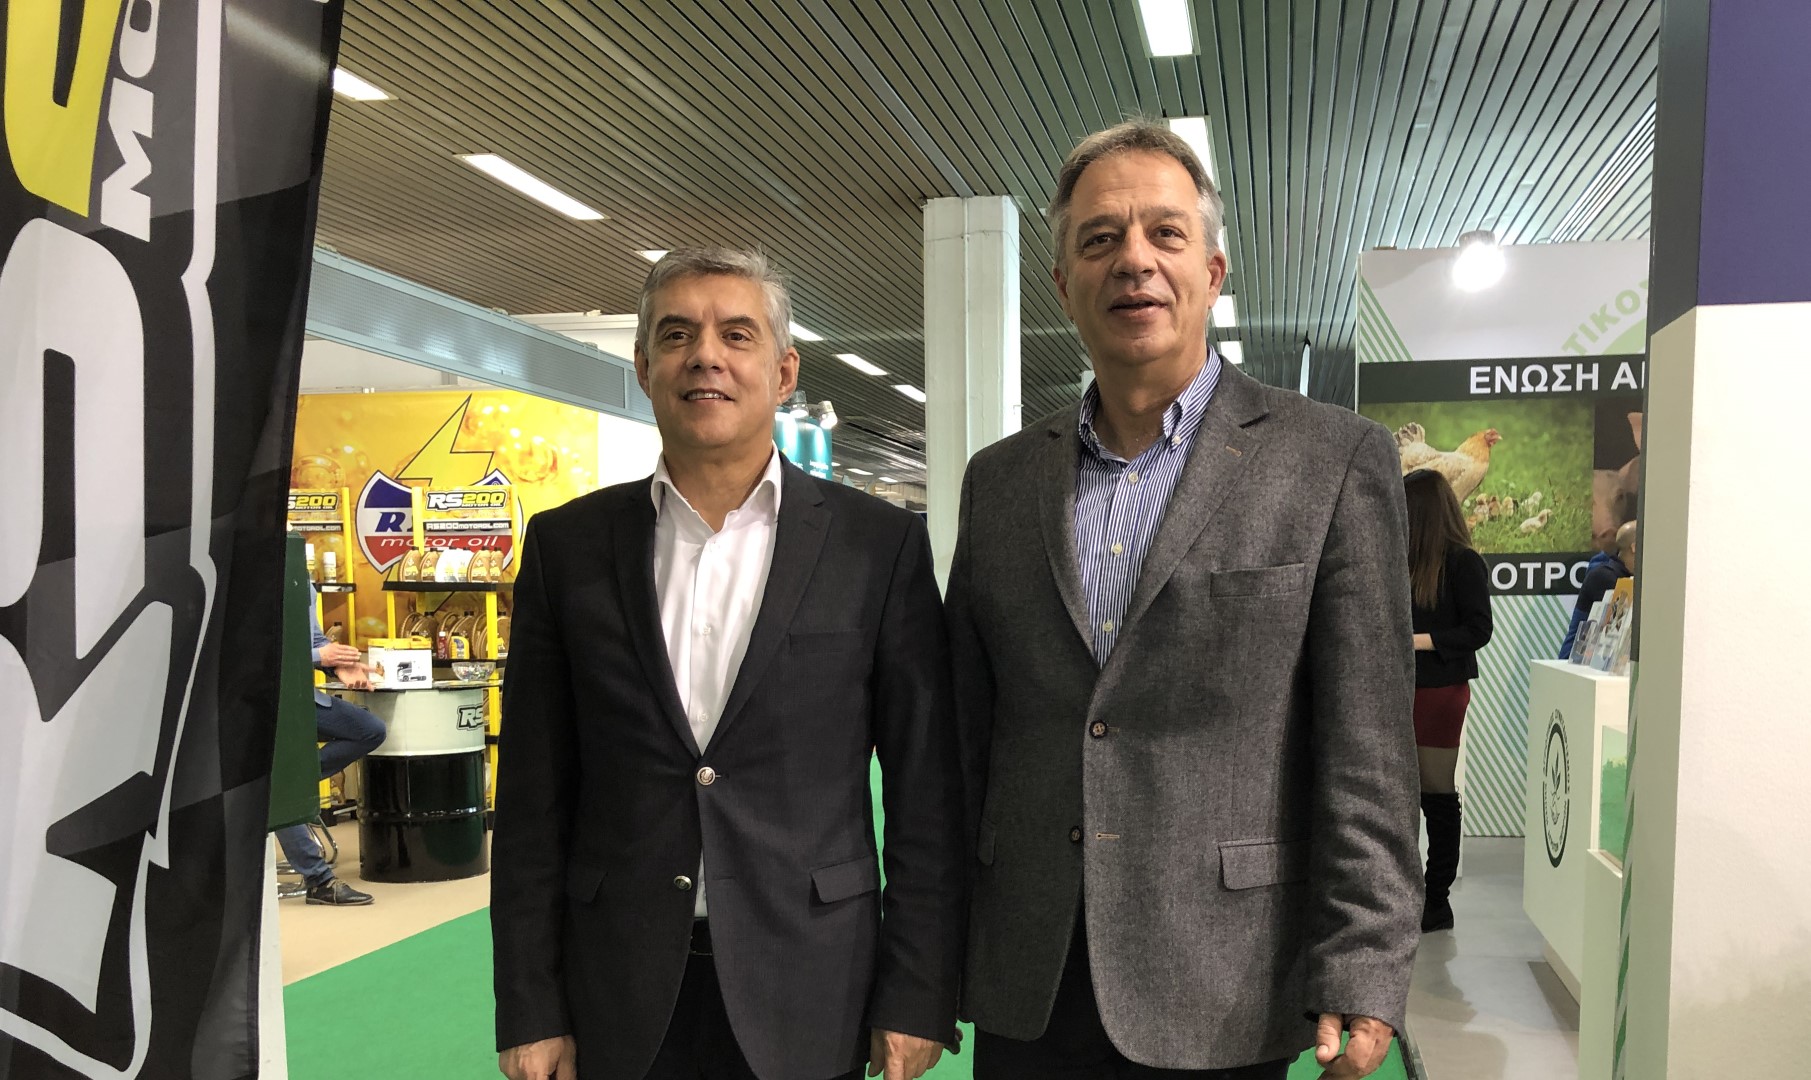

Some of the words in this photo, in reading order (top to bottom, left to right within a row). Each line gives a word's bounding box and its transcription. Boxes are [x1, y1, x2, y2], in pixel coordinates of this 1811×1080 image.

[1470, 363, 1599, 394] ΕΝΩΣΗ
[1610, 361, 1645, 390] Α
[428, 492, 505, 509] RS200
[468, 536, 498, 546] oil
